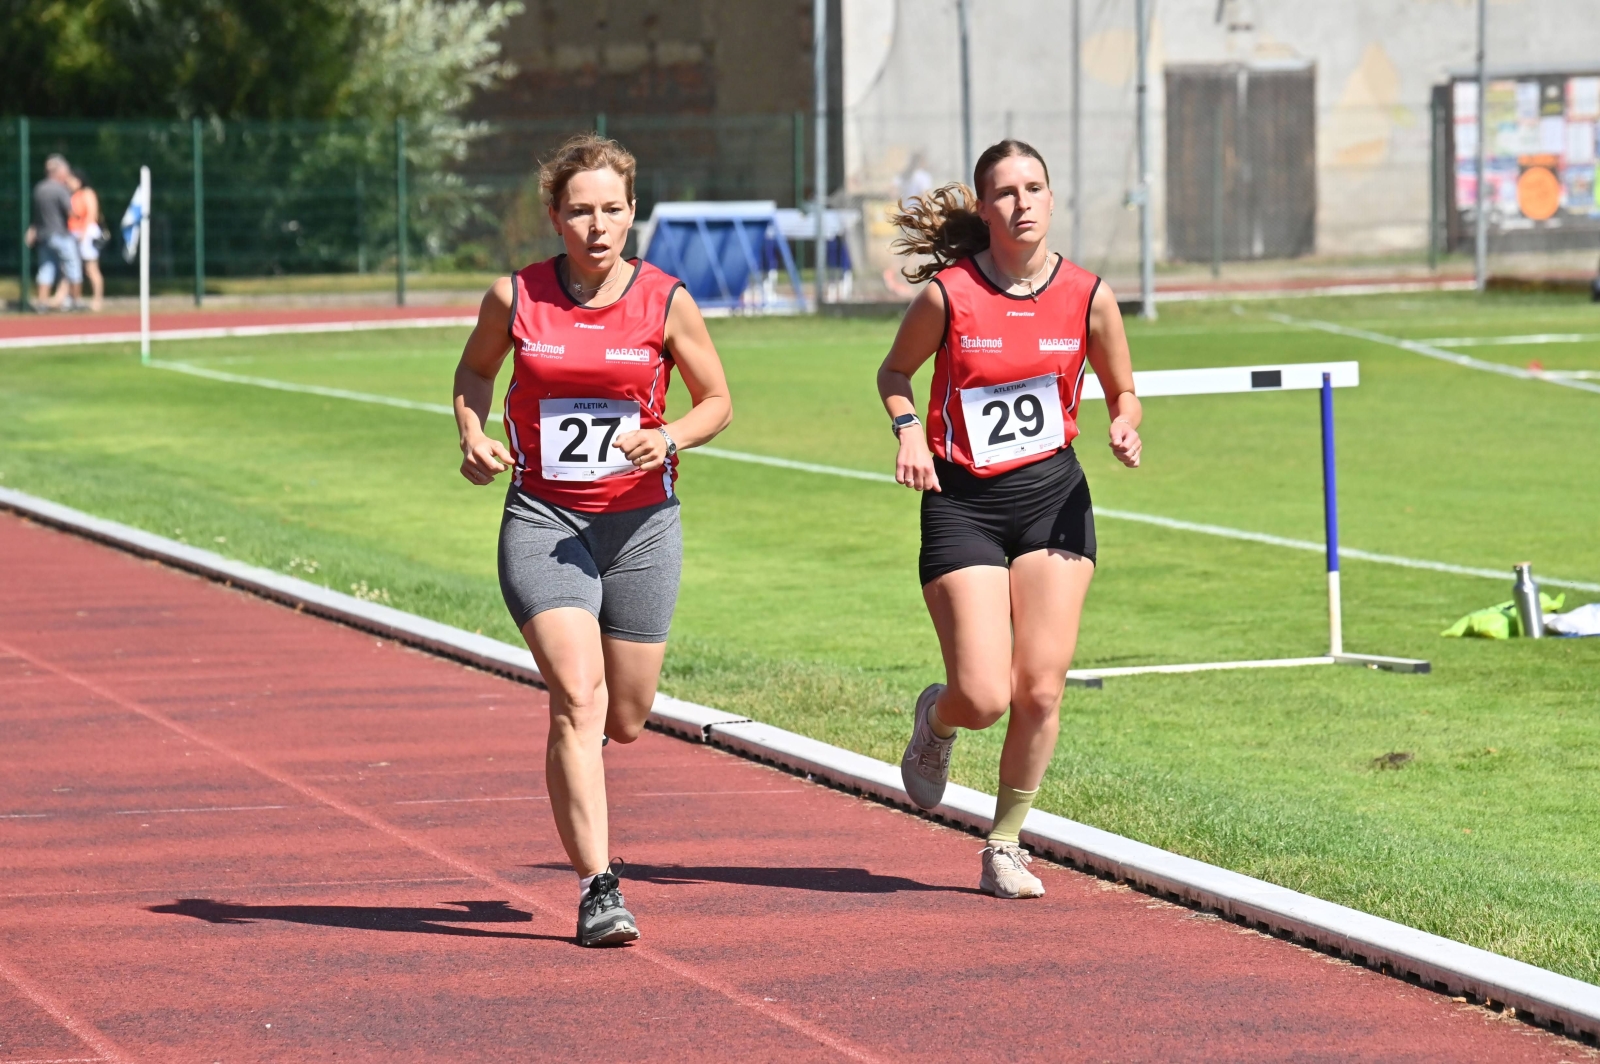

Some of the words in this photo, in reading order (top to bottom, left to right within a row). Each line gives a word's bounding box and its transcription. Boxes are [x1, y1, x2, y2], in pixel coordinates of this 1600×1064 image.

[1039, 338, 1080, 346] MARATON
[606, 348, 649, 357] MARATON
[993, 382, 1027, 394] ATLETIKA
[573, 402, 609, 410] ATLETIKA
[981, 393, 1044, 446] 29
[558, 417, 621, 463] 27
